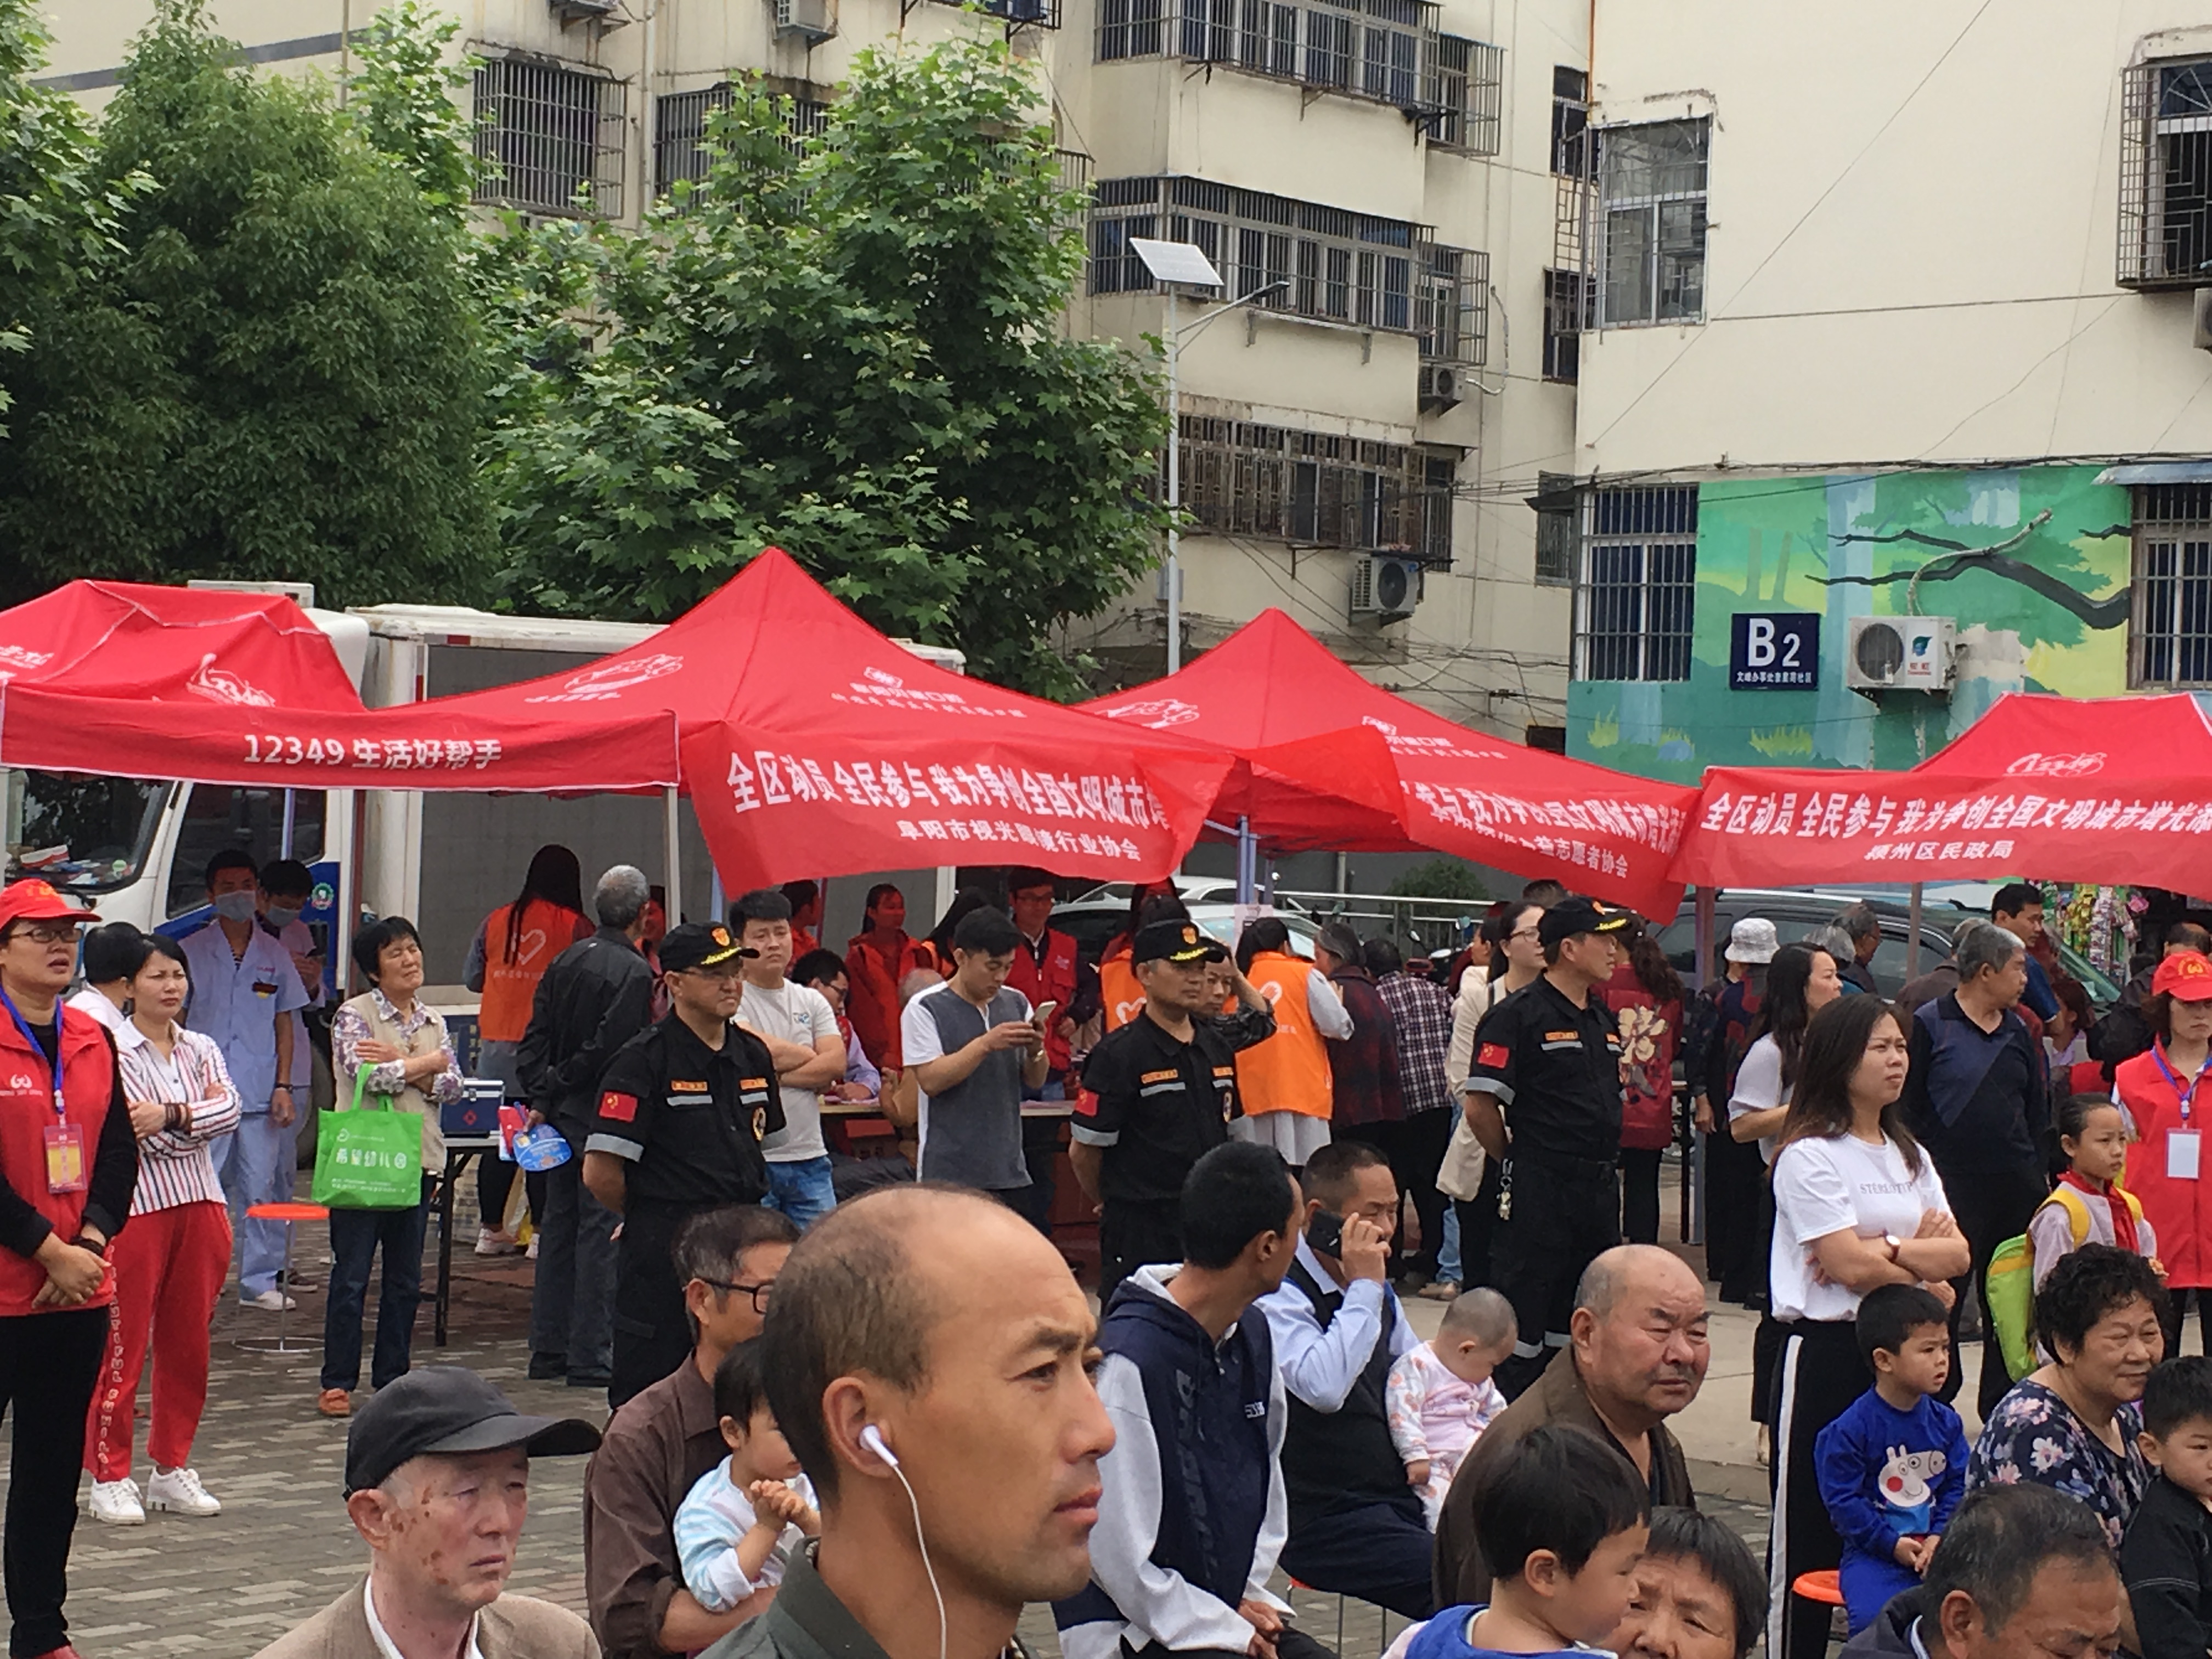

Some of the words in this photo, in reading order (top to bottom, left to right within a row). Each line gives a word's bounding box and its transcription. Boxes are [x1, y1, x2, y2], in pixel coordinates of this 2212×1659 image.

[244, 734, 345, 765] 12349
[352, 738, 502, 770] 生活好帮手
